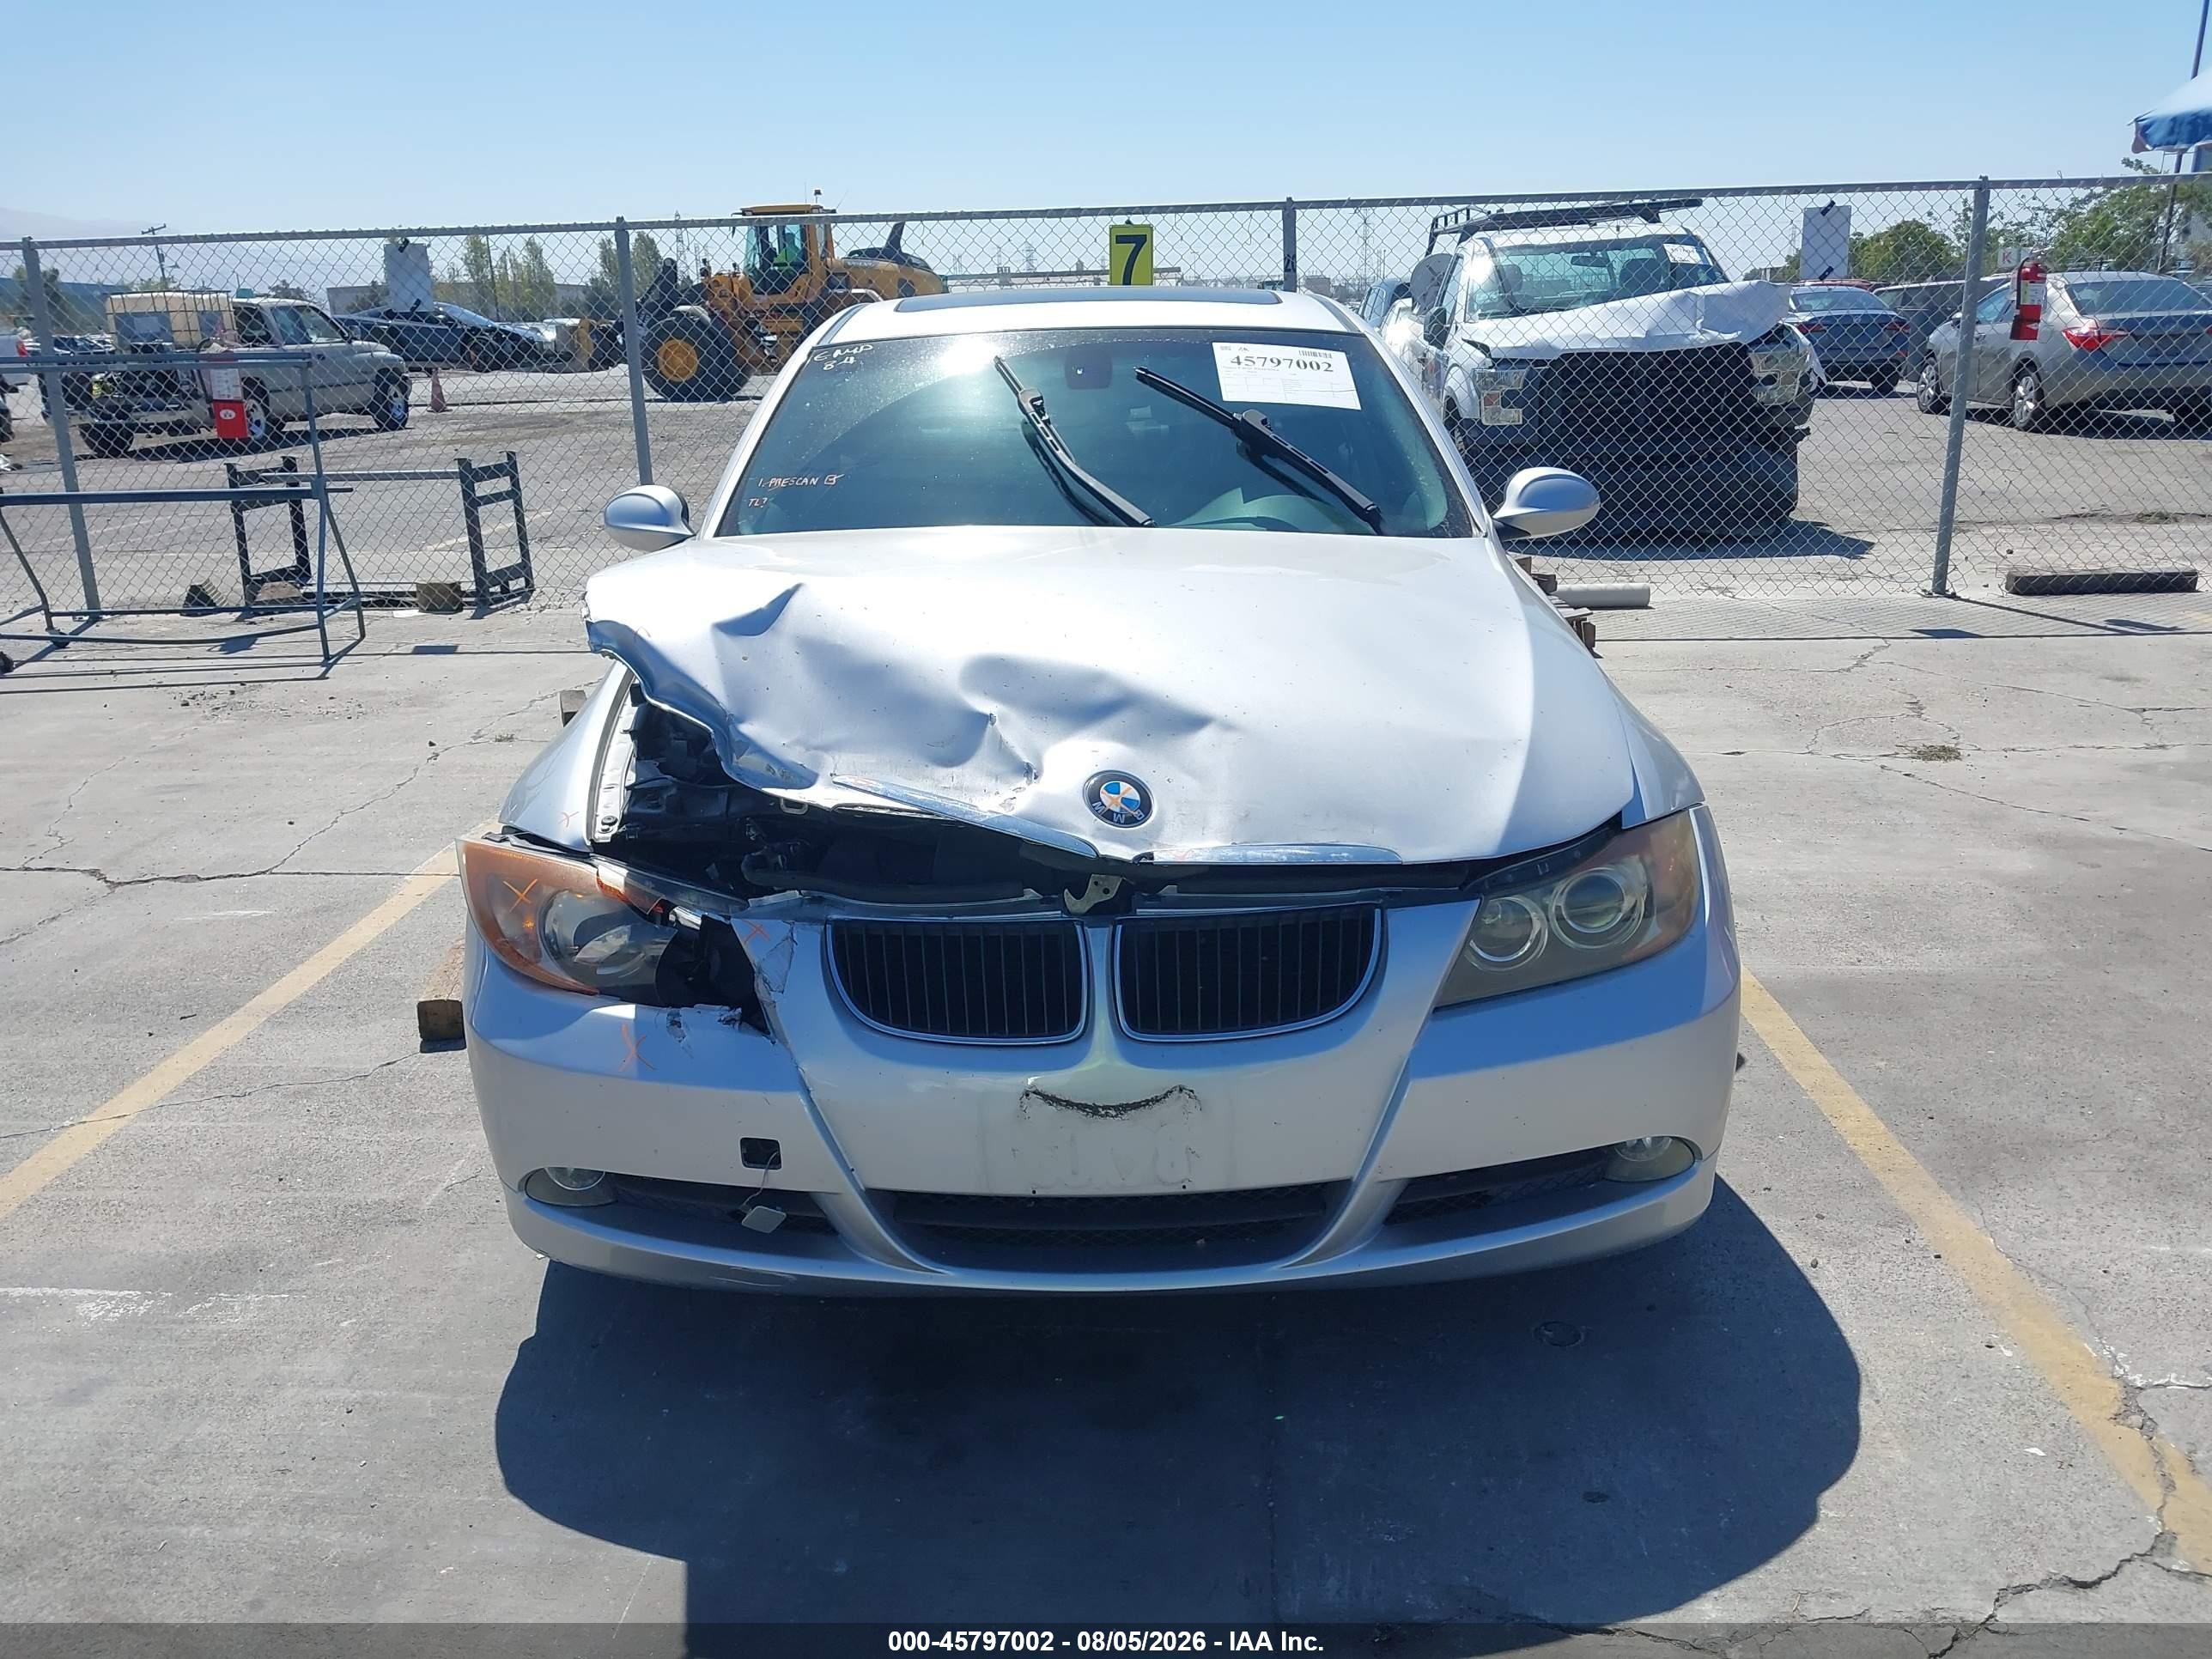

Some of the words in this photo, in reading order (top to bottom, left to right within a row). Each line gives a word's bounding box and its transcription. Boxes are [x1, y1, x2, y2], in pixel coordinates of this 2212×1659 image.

[1115, 234, 1147, 286] 7
[2002, 252, 2012, 264] K
[1230, 355, 1334, 373] 45797002
[768, 477, 819, 489] PRESCAN
[1092, 801, 1145, 823] BMW
